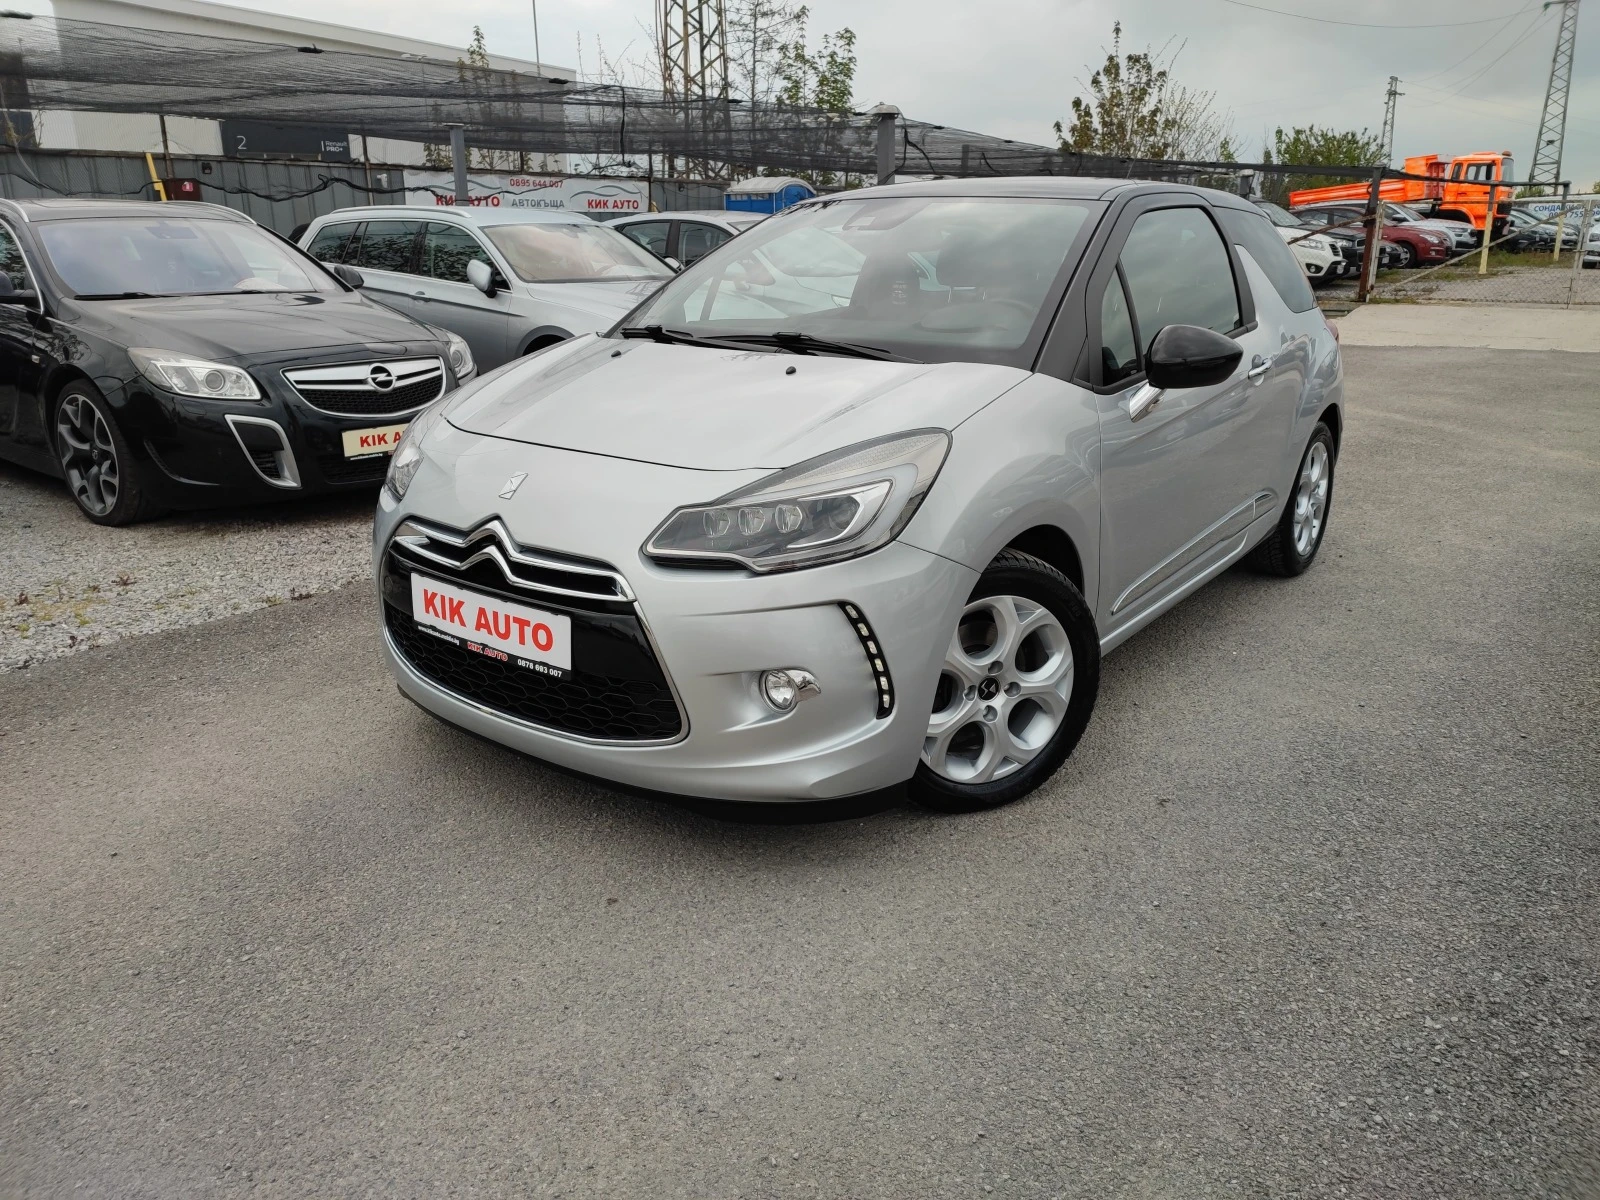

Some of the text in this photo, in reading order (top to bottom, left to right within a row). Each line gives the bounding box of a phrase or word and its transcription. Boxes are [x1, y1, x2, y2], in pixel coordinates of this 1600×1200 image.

[236, 135, 247, 150] 2
[509, 178, 530, 187] 0895
[532, 180, 547, 188] 644
[436, 195, 456, 206] КИ
[511, 198, 565, 209] АВТОКЪЩА
[587, 199, 639, 210] КИК АУТО
[359, 432, 389, 448] KIK
[423, 588, 554, 652] KIK AUTO
[467, 641, 509, 662] KIK AUTO
[517, 658, 534, 670] 0878
[549, 668, 563, 678] 007
